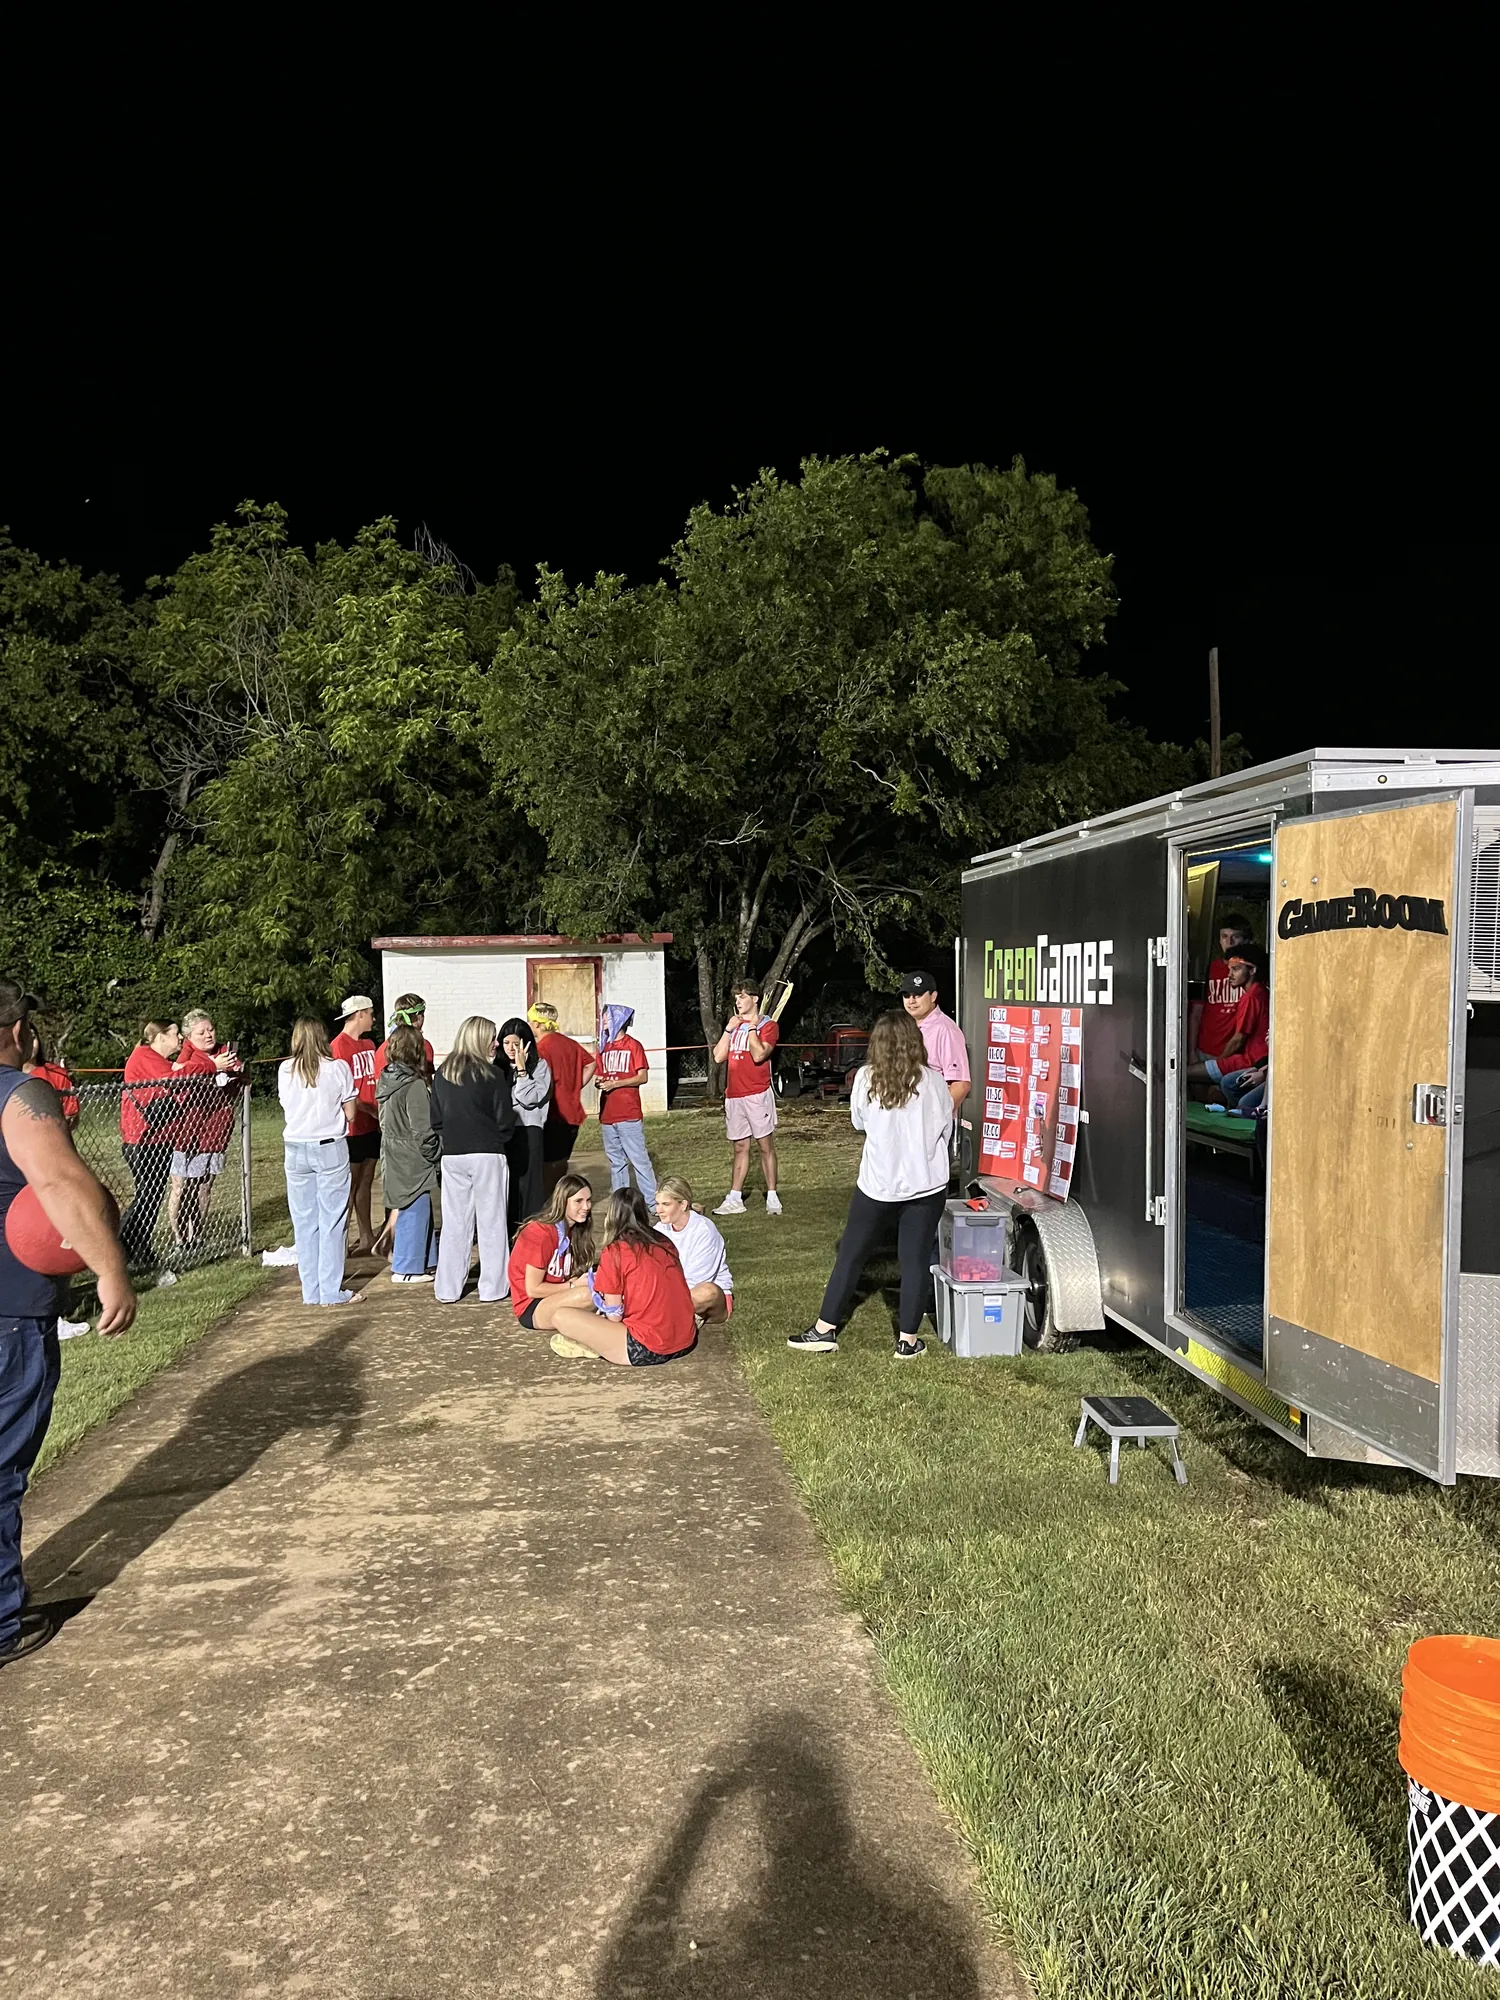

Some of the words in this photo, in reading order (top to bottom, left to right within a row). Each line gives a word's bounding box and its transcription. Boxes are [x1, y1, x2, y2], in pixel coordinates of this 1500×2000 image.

[984, 934, 1114, 1005] GreenGames
[988, 1048, 1004, 1060] 11:00
[987, 1088, 1001, 1100] 11:30
